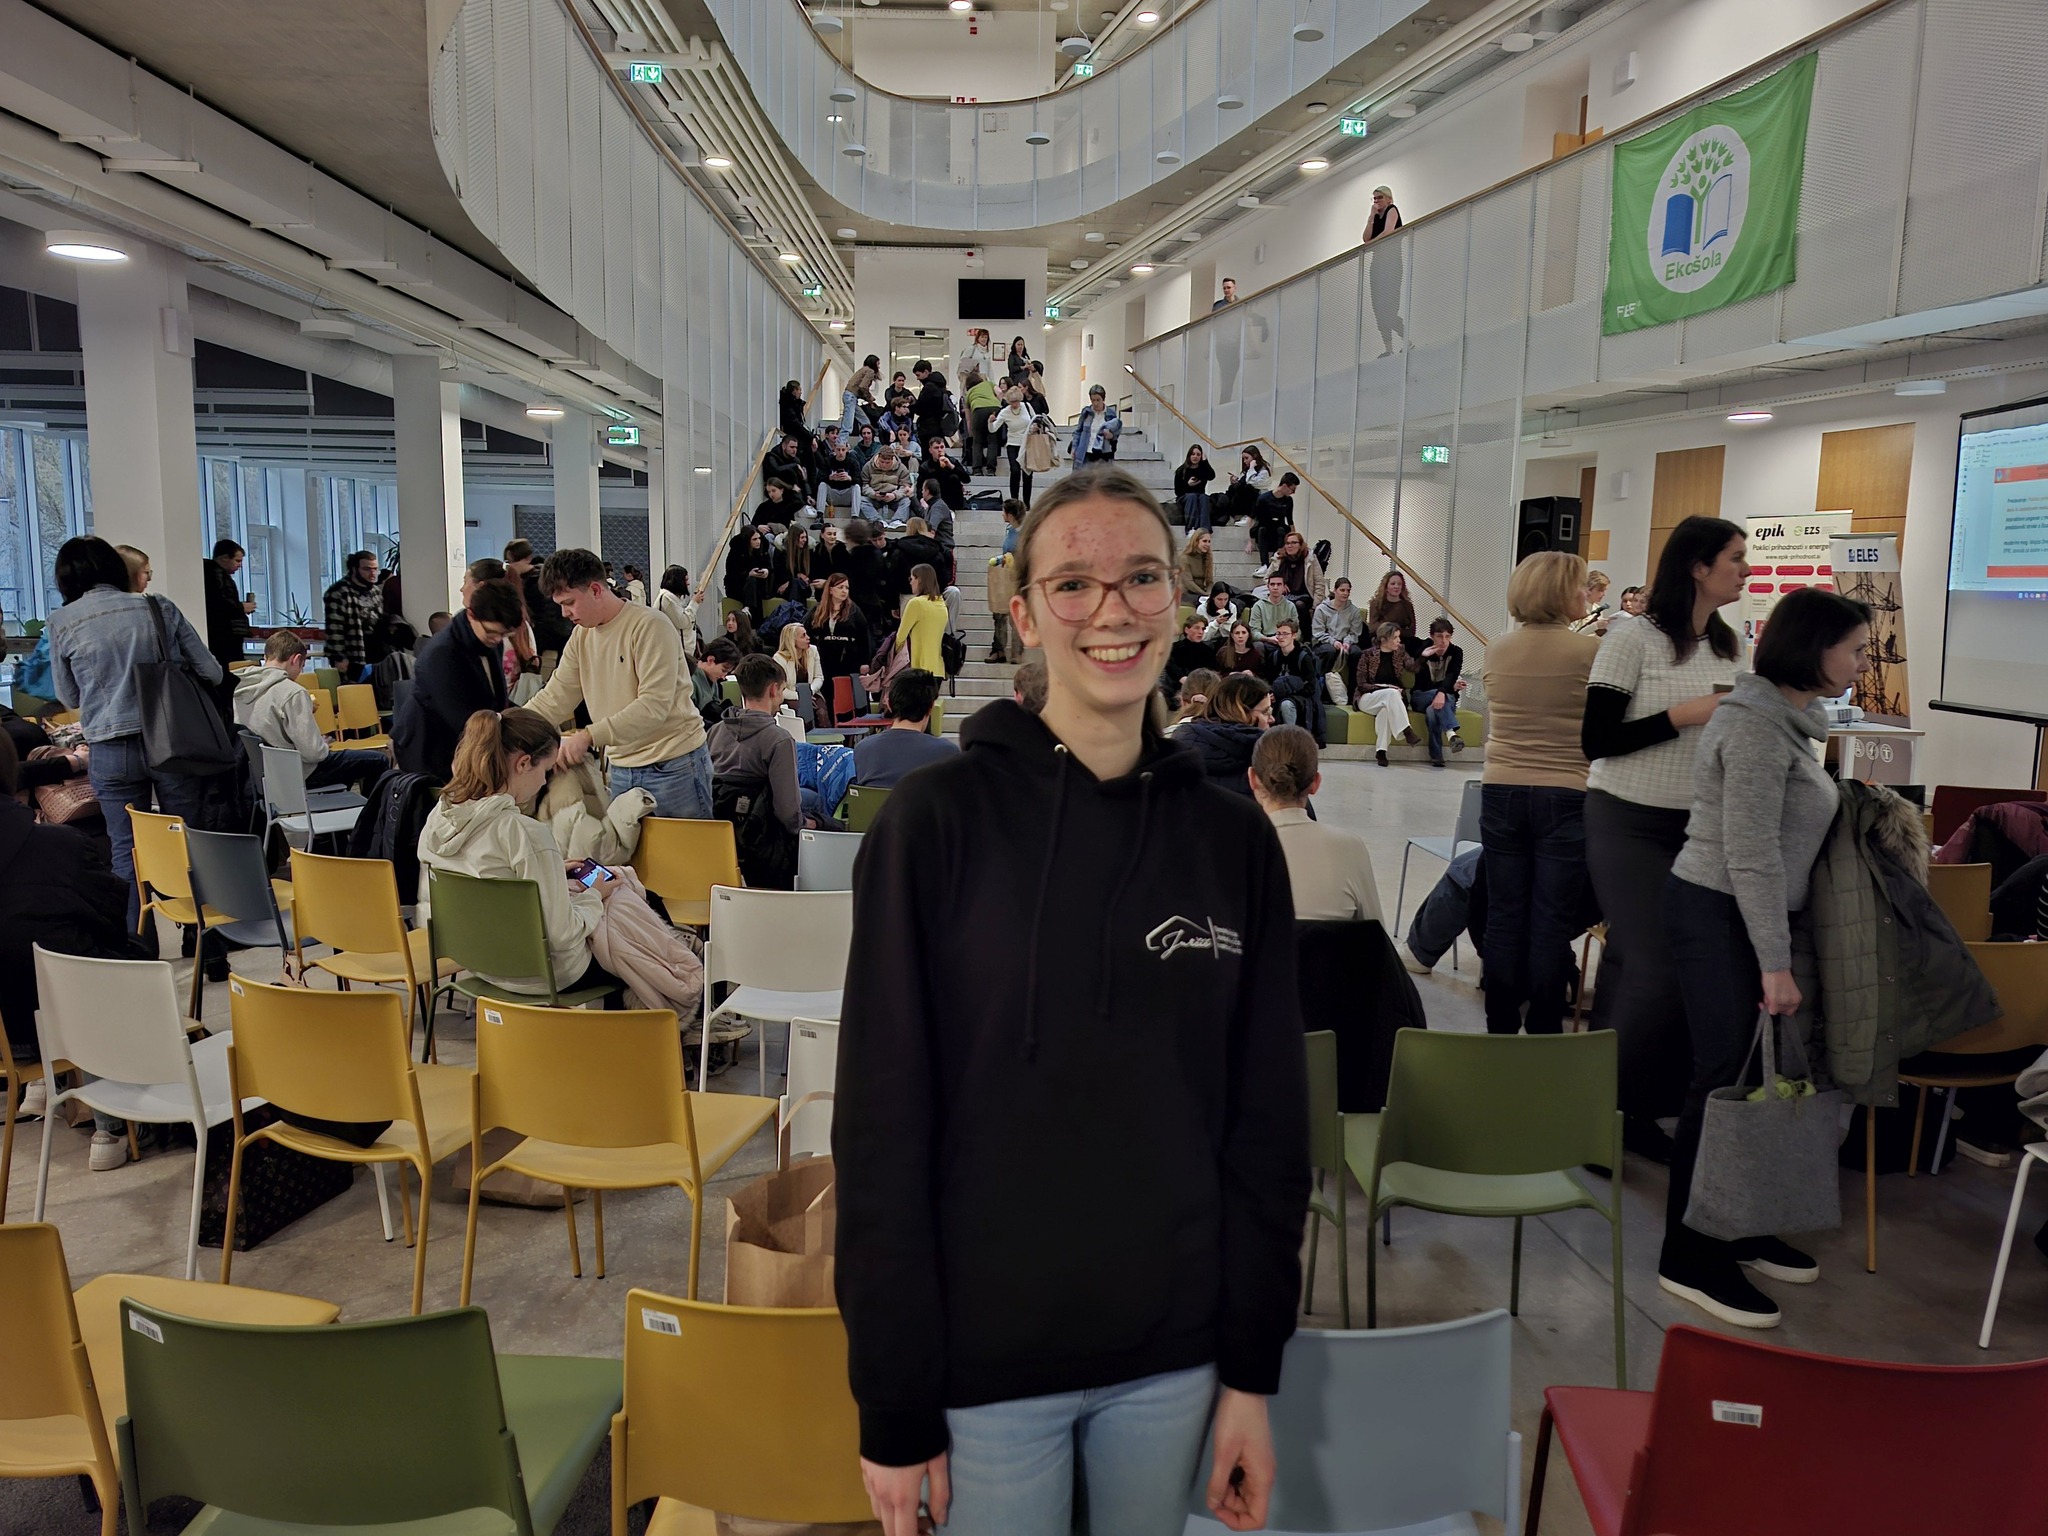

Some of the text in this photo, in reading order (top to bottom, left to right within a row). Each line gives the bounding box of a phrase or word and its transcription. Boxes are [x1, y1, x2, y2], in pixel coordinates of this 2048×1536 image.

[1665, 250, 1721, 282] Ekošola
[1756, 523, 1785, 540] epik
[1804, 526, 1821, 535] EZS
[1771, 543, 1804, 551] prihodnosti
[1857, 549, 1879, 562] ELES
